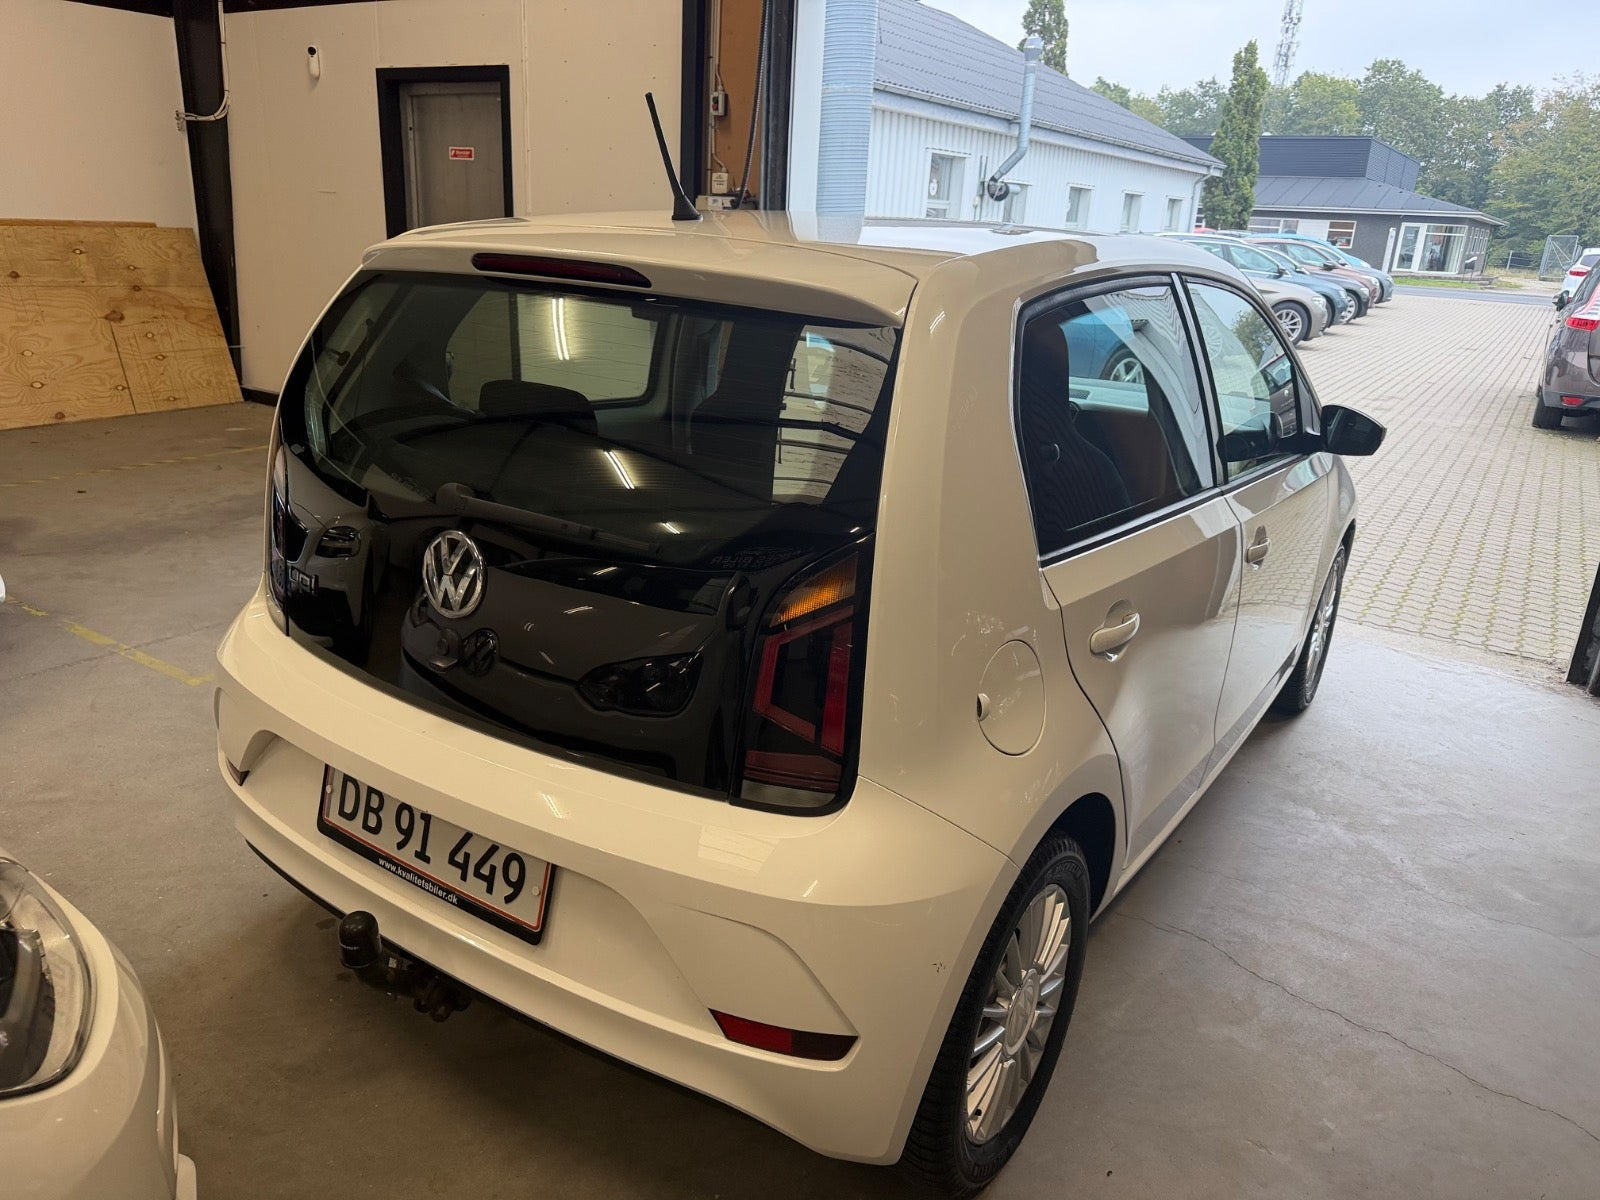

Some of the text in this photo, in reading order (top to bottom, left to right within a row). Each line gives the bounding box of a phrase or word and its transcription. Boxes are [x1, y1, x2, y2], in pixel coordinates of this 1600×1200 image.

[338, 773, 526, 904] DB 91 449
[378, 857, 458, 905] www.kvalitetsbiler.dk
